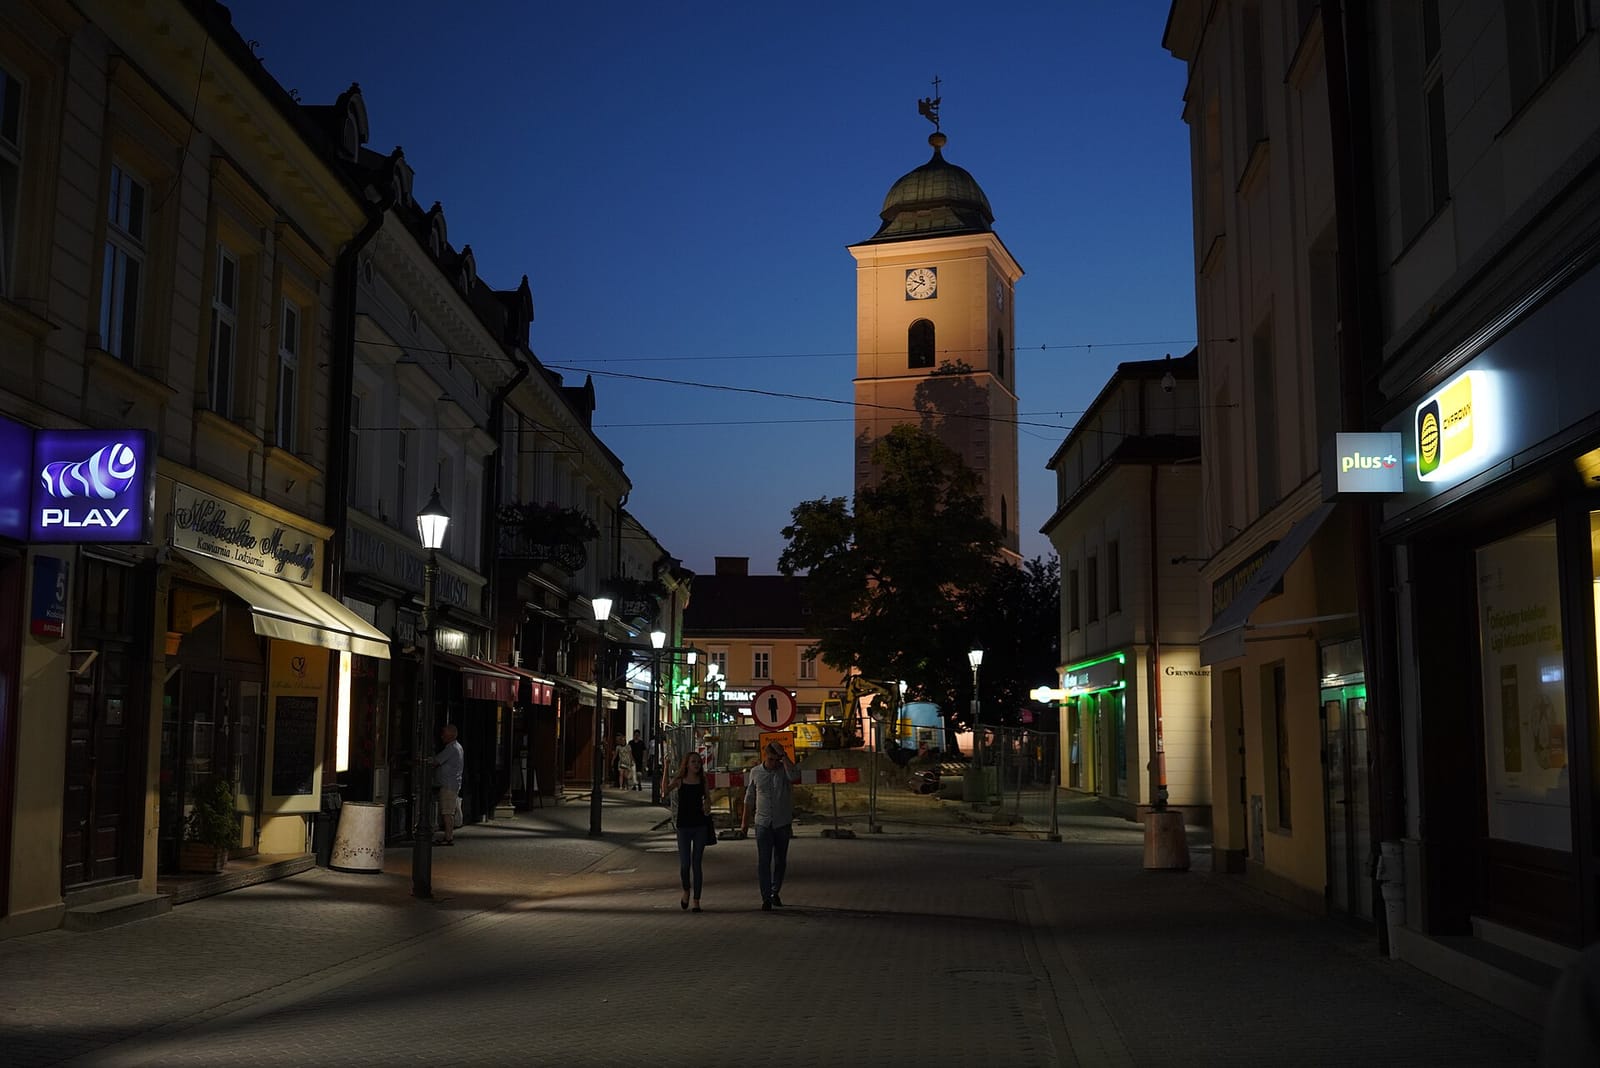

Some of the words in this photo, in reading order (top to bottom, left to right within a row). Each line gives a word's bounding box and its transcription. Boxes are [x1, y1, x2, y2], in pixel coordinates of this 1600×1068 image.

[1342, 452, 1382, 472] plus
[41, 508, 130, 527] PLAY
[197, 537, 231, 558] Kawiarnia
[55, 573, 65, 602] 5
